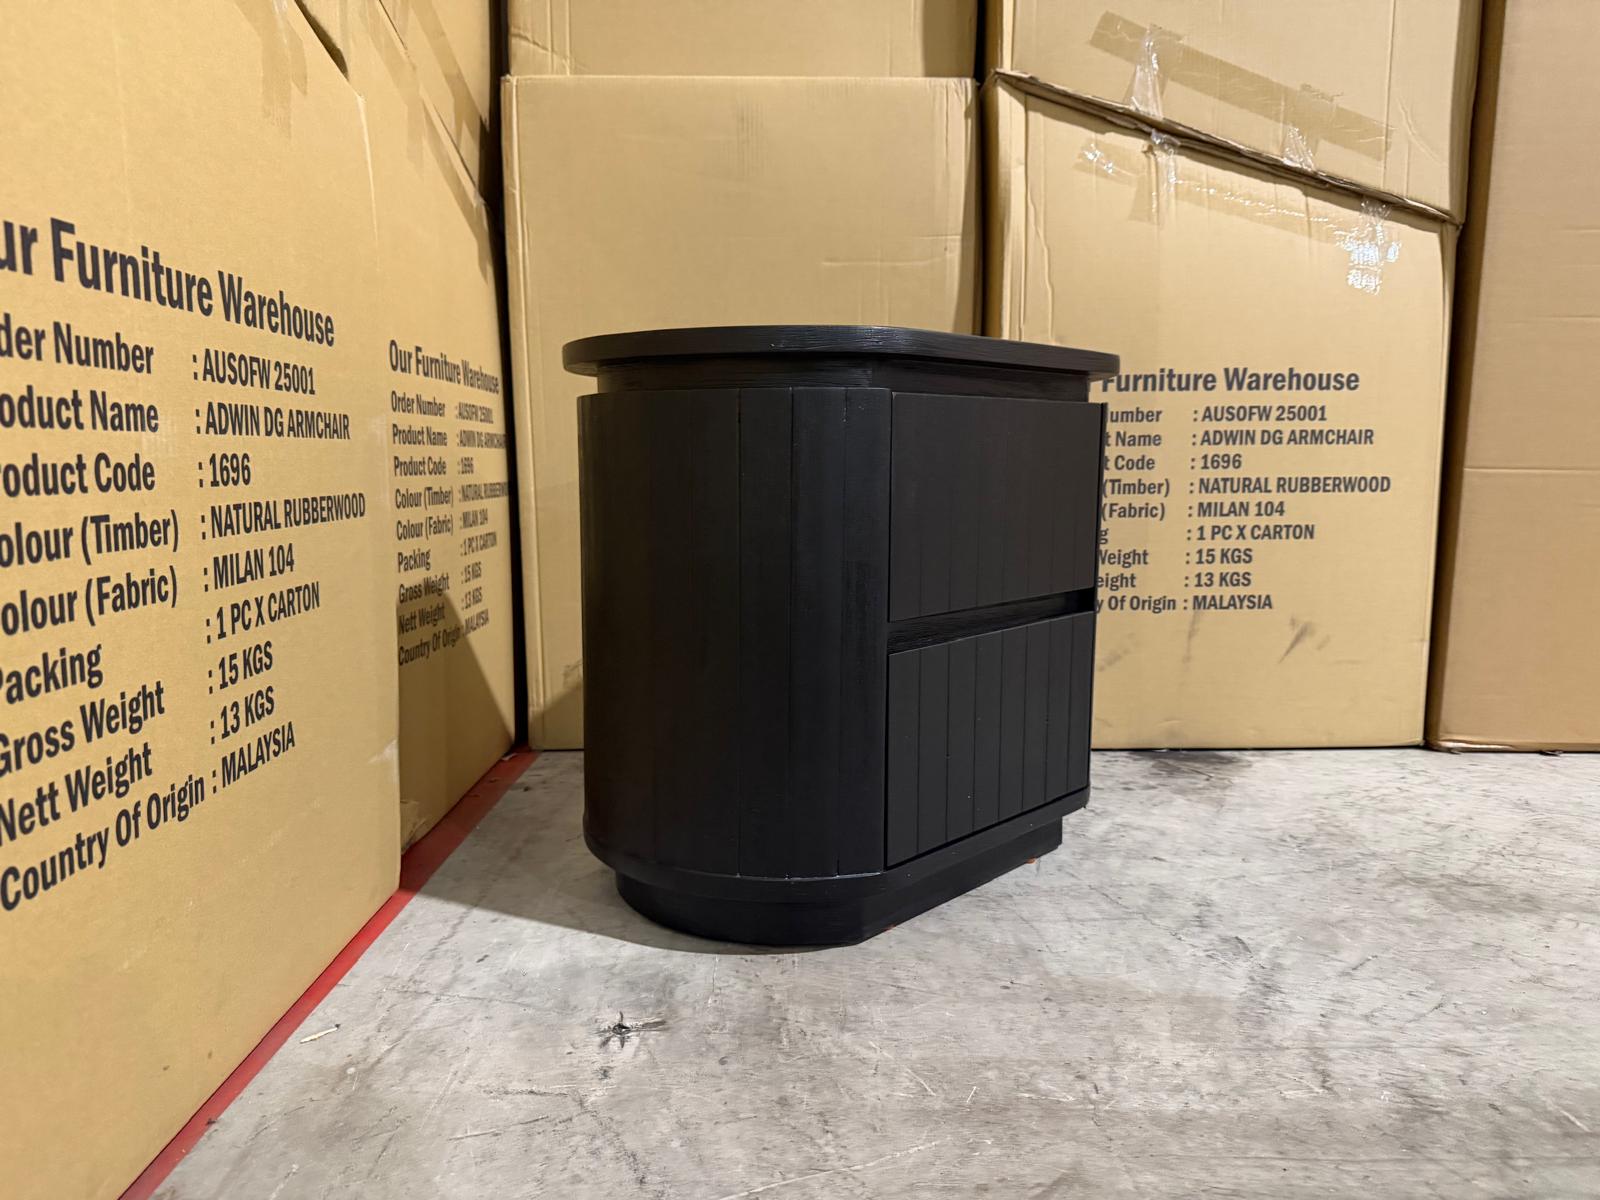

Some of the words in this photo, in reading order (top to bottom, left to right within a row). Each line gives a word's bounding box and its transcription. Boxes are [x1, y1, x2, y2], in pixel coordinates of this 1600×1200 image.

[0, 220, 38, 275] ur
[50, 217, 213, 317] Furniture
[217, 270, 335, 347] Warehouse
[0, 312, 46, 361] der
[53, 321, 154, 374] Number
[202, 349, 271, 389] AUSOFW
[274, 361, 316, 395] 25001
[389, 339, 412, 374] Our
[414, 345, 461, 385] Furniture
[462, 359, 500, 395] Warehouse
[1223, 367, 1360, 392] Warehouse
[0, 384, 84, 430] oduct
[90, 389, 159, 433] Name
[205, 401, 260, 436] ADWIN
[264, 407, 284, 438] DG
[287, 409, 350, 440] ARMCHAIR
[391, 390, 414, 414] Order
[416, 393, 445, 418] Number
[1107, 406, 1163, 423] umber
[1201, 405, 1272, 422] AUSOFW
[1275, 405, 1327, 421] 25001
[392, 423, 426, 446] Product
[426, 425, 447, 446] Name
[1115, 431, 1162, 447] Name
[1200, 429, 1256, 446] ADWIN
[1260, 429, 1284, 445] DG
[1287, 428, 1374, 445] ARMCHAIR
[393, 455, 427, 476] Product
[428, 456, 446, 476] Code
[1114, 454, 1155, 470] Code
[1200, 453, 1242, 470] 1696
[0, 453, 88, 498] oduct
[94, 453, 155, 493] Code
[209, 453, 251, 488] 1696
[1102, 478, 1170, 498] (Timber)
[1198, 477, 1272, 494] NATURAL
[1276, 475, 1391, 493] RUBBERWOOD
[395, 487, 422, 509] Colour
[424, 485, 453, 510] (Timber)
[1101, 502, 1166, 521] (Fabric)
[1197, 501, 1249, 518] MILAN
[1254, 501, 1285, 517] 104
[0, 522, 73, 568] olour
[81, 509, 179, 566] (Timber)
[210, 499, 281, 538] NATURAL
[284, 492, 366, 529] RUBBERWOOD
[396, 517, 423, 541] Colour
[425, 514, 454, 540] (Fabric)
[1197, 525, 1206, 541] 1
[1211, 525, 1233, 541] PC
[1235, 524, 1246, 540] X
[1250, 524, 1316, 540] CARTON
[397, 549, 431, 573] Packing
[1195, 548, 1216, 564] 15
[1219, 548, 1254, 564] KGS
[1, 590, 77, 636] olour
[85, 565, 178, 627] (Fabric)
[213, 549, 264, 589] MILAN
[269, 543, 295, 577] 104
[399, 583, 423, 604] Gross
[424, 572, 450, 597] Weight
[1096, 573, 1136, 592] eight
[1193, 572, 1214, 587] 13
[1218, 571, 1252, 587] KGS
[1108, 595, 1126, 611] Of
[1129, 595, 1177, 614] Origin
[1192, 594, 1273, 610] MALAYSIA
[399, 612, 417, 635] Nett
[419, 603, 445, 627] Weight
[0, 644, 103, 705] acking
[216, 606, 226, 640] 1
[231, 599, 251, 635] PC
[254, 596, 265, 628] X
[268, 581, 320, 621] CARTON
[399, 636, 431, 666] Country
[432, 629, 442, 652] Of
[0, 720, 75, 778] Gross
[80, 680, 165, 743] Weight
[218, 653, 239, 691] 15
[243, 640, 273, 680] KGS
[0, 781, 61, 847] Nett
[64, 742, 152, 813] Weight
[220, 702, 241, 740] 13
[244, 685, 275, 727] KGS
[0, 827, 109, 911] Country
[115, 801, 141, 848] Of
[147, 774, 205, 830] Origin
[221, 721, 296, 788] MALAYSIA
